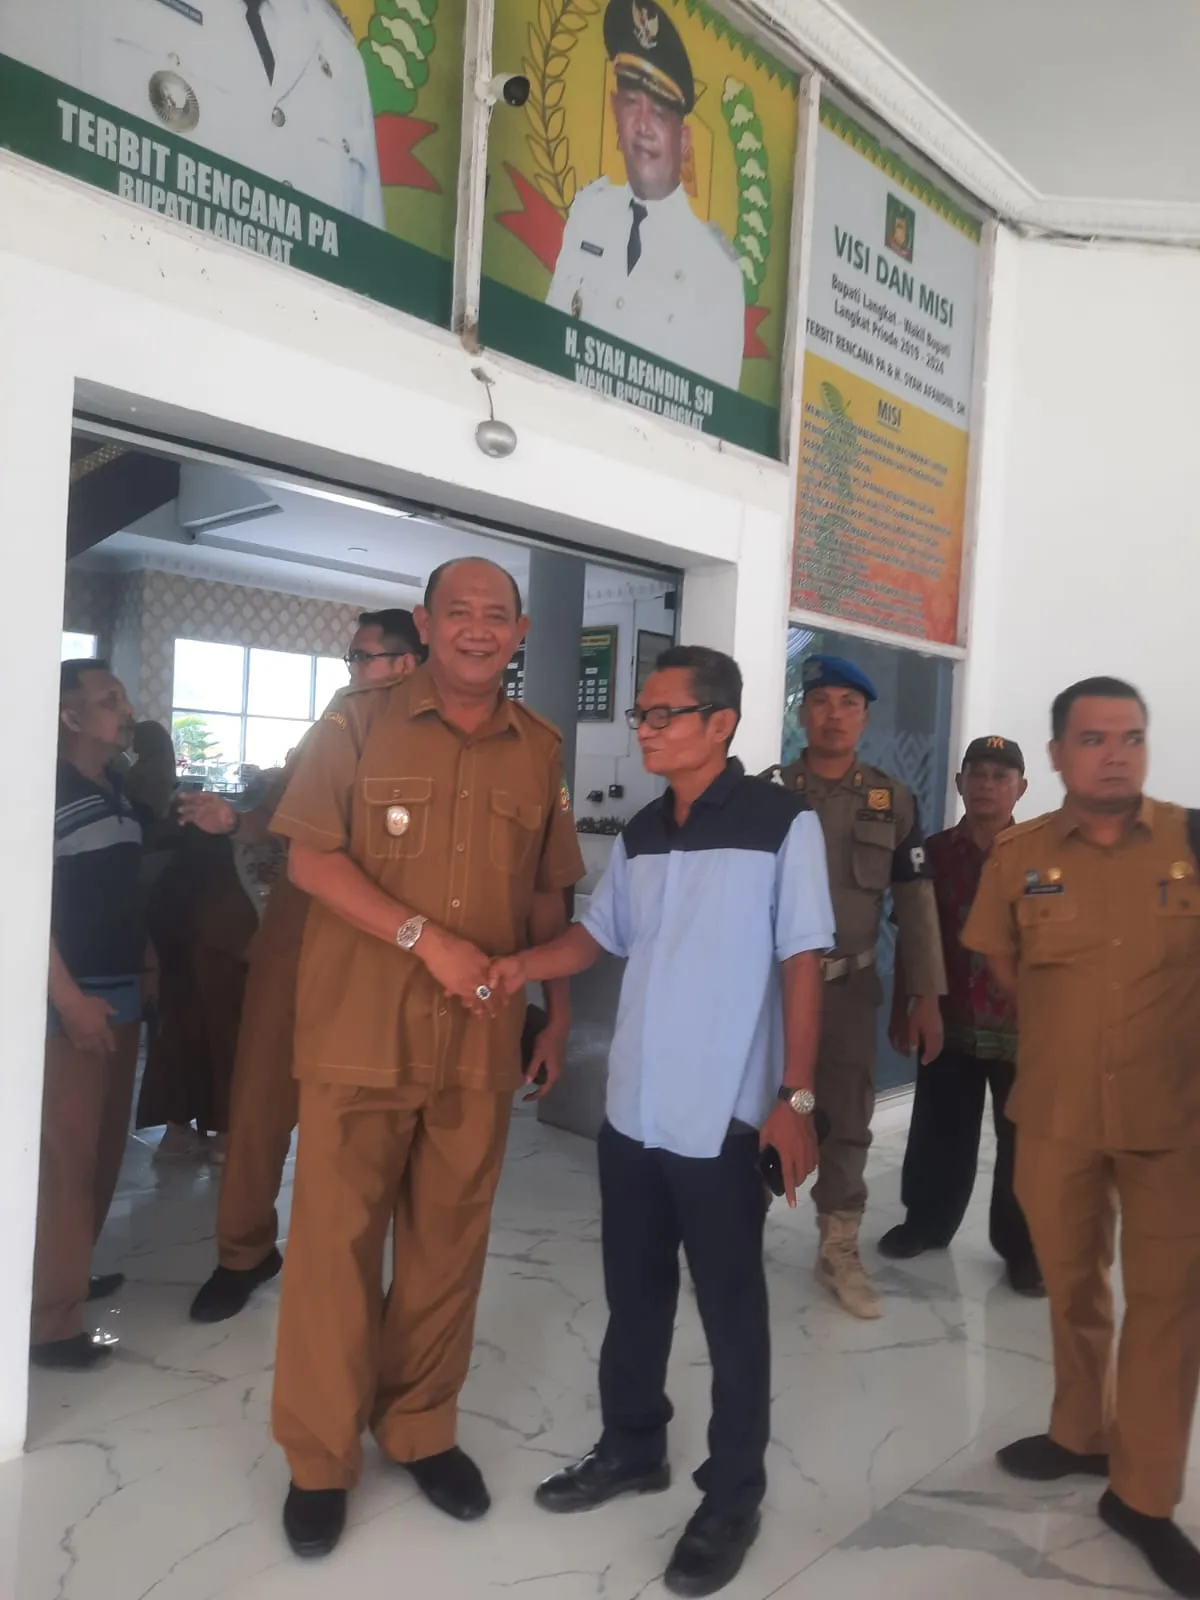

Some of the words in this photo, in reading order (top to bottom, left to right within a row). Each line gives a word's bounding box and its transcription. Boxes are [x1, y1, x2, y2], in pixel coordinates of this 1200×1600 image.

[57, 98, 171, 182] TERBIT
[177, 153, 302, 240] RENCANA
[308, 211, 339, 257] PA
[118, 171, 198, 229] BUPATI
[203, 206, 294, 266] LANGKAT
[832, 273, 862, 303] Bupati
[863, 292, 897, 326] Langkat
[835, 224, 870, 275] VISI
[876, 254, 914, 303] DAN
[919, 283, 954, 328] MISI
[806, 317, 834, 346] TERBIT
[835, 333, 875, 367] RENCANA
[834, 300, 870, 333] Langkat
[565, 326, 581, 360] H.
[584, 335, 626, 379] SYAH
[694, 384, 714, 416] SH
[575, 362, 616, 398] WAKIL
[877, 399, 902, 427] MISI
